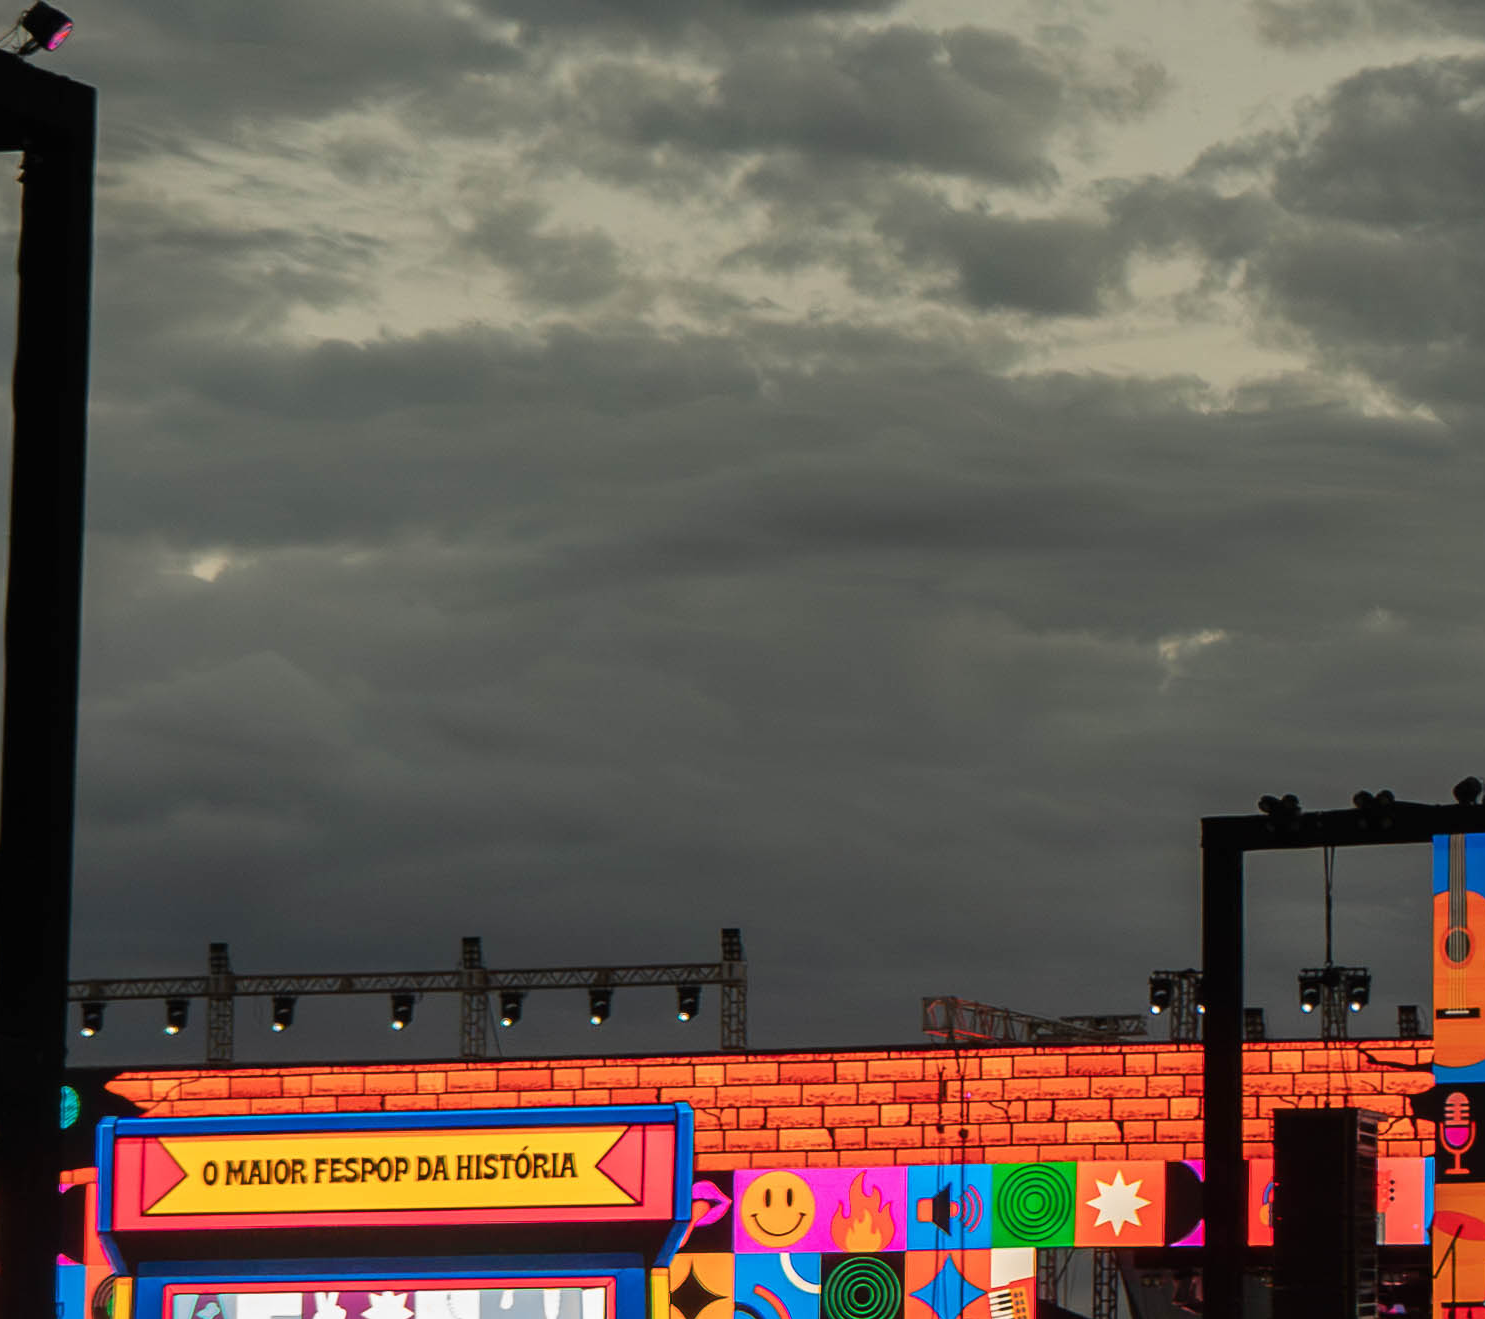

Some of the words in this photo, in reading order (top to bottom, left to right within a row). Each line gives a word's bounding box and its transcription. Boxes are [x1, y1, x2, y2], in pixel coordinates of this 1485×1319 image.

[203, 1160, 219, 1187] O
[225, 1159, 307, 1186] MAIOR
[314, 1156, 410, 1184] FESPOP
[417, 1154, 450, 1182] DA
[456, 1145, 578, 1181] HISTÓRIA
